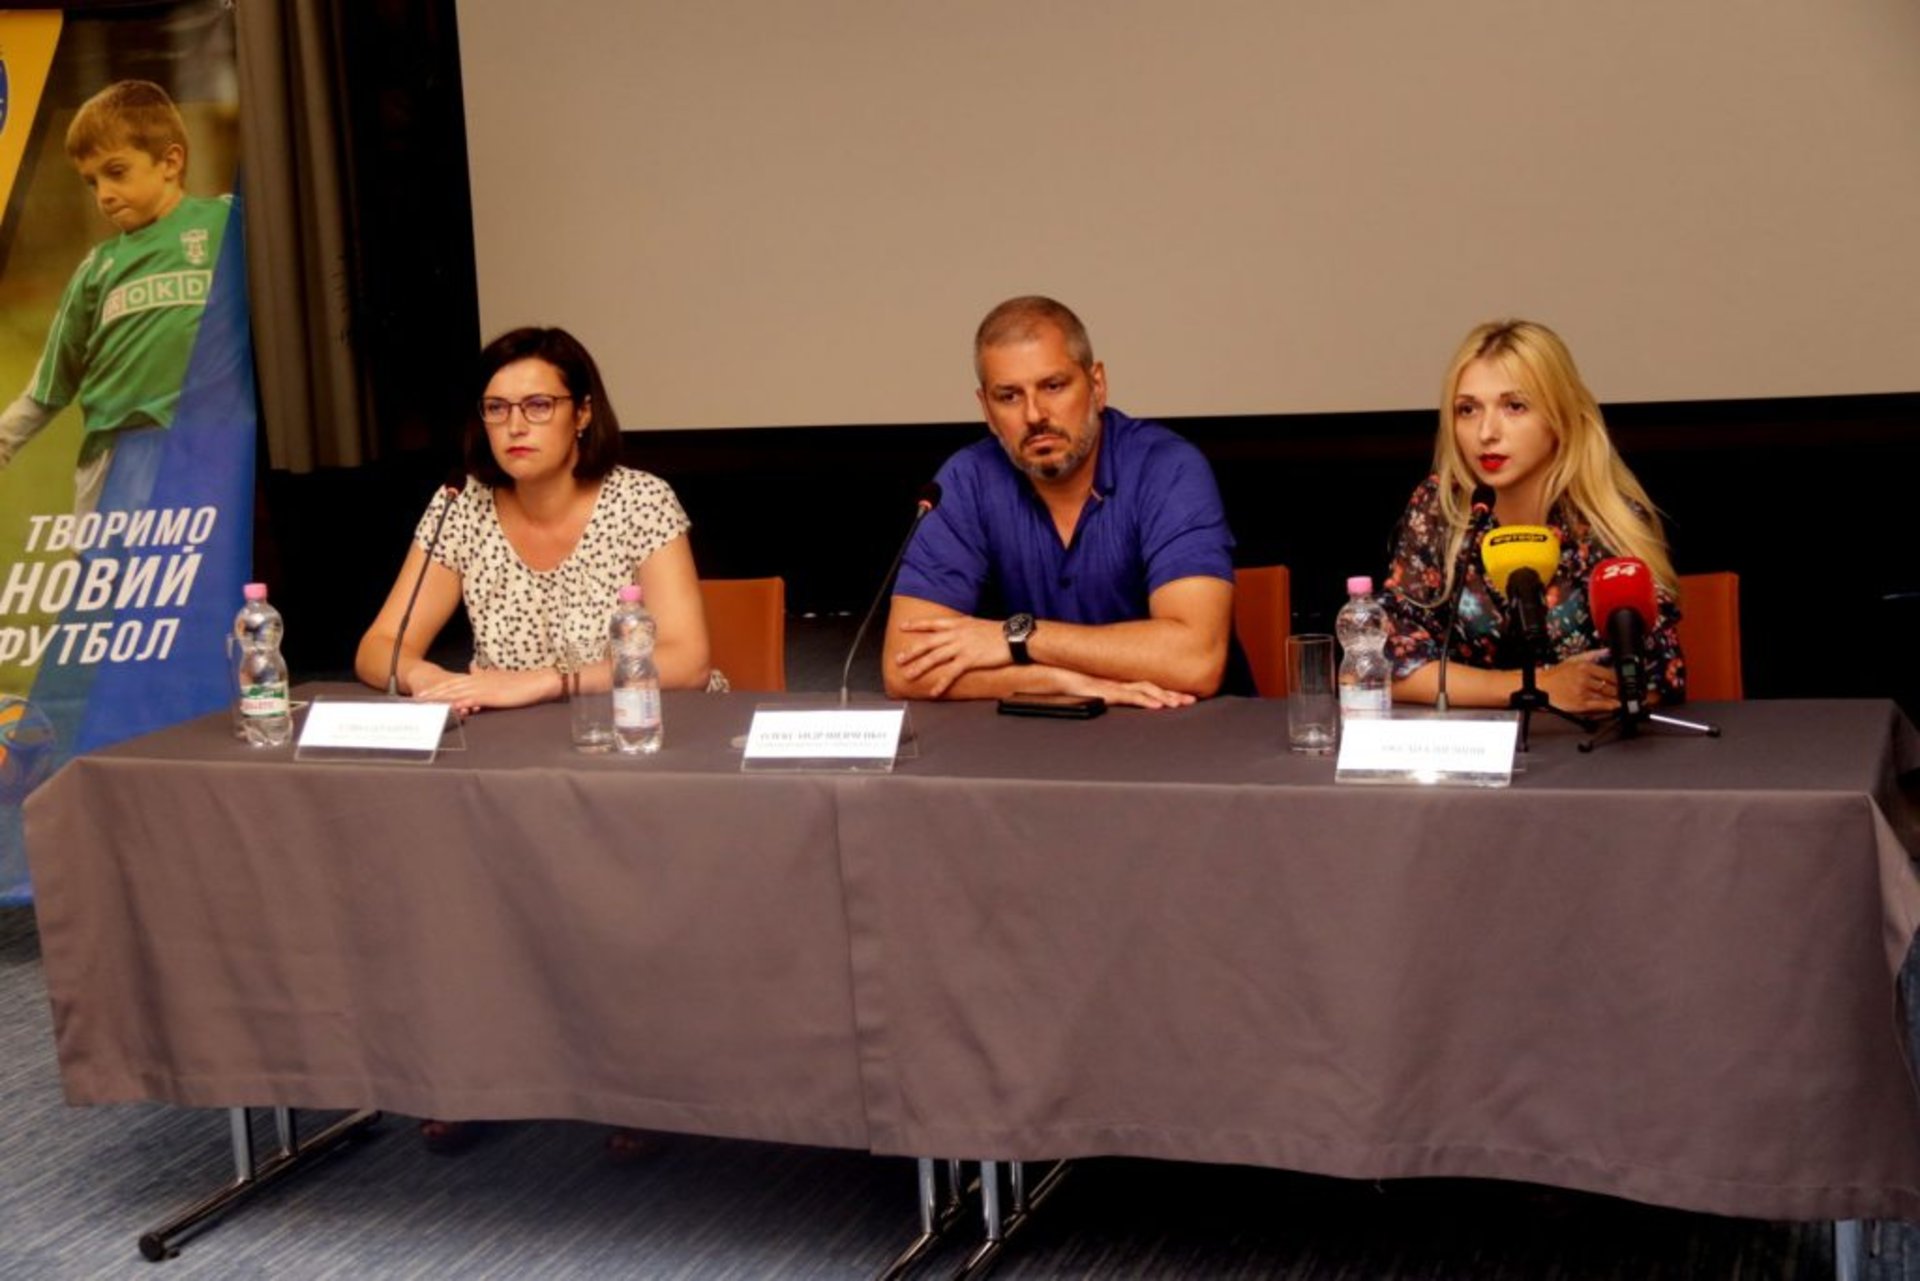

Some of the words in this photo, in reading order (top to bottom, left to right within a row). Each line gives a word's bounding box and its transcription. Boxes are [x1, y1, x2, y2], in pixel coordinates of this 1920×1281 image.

[128, 278, 204, 304] OKD
[25, 506, 218, 553] ТВОРИМО
[0, 545, 203, 616] НОВИЙ
[1602, 564, 1636, 580] 24
